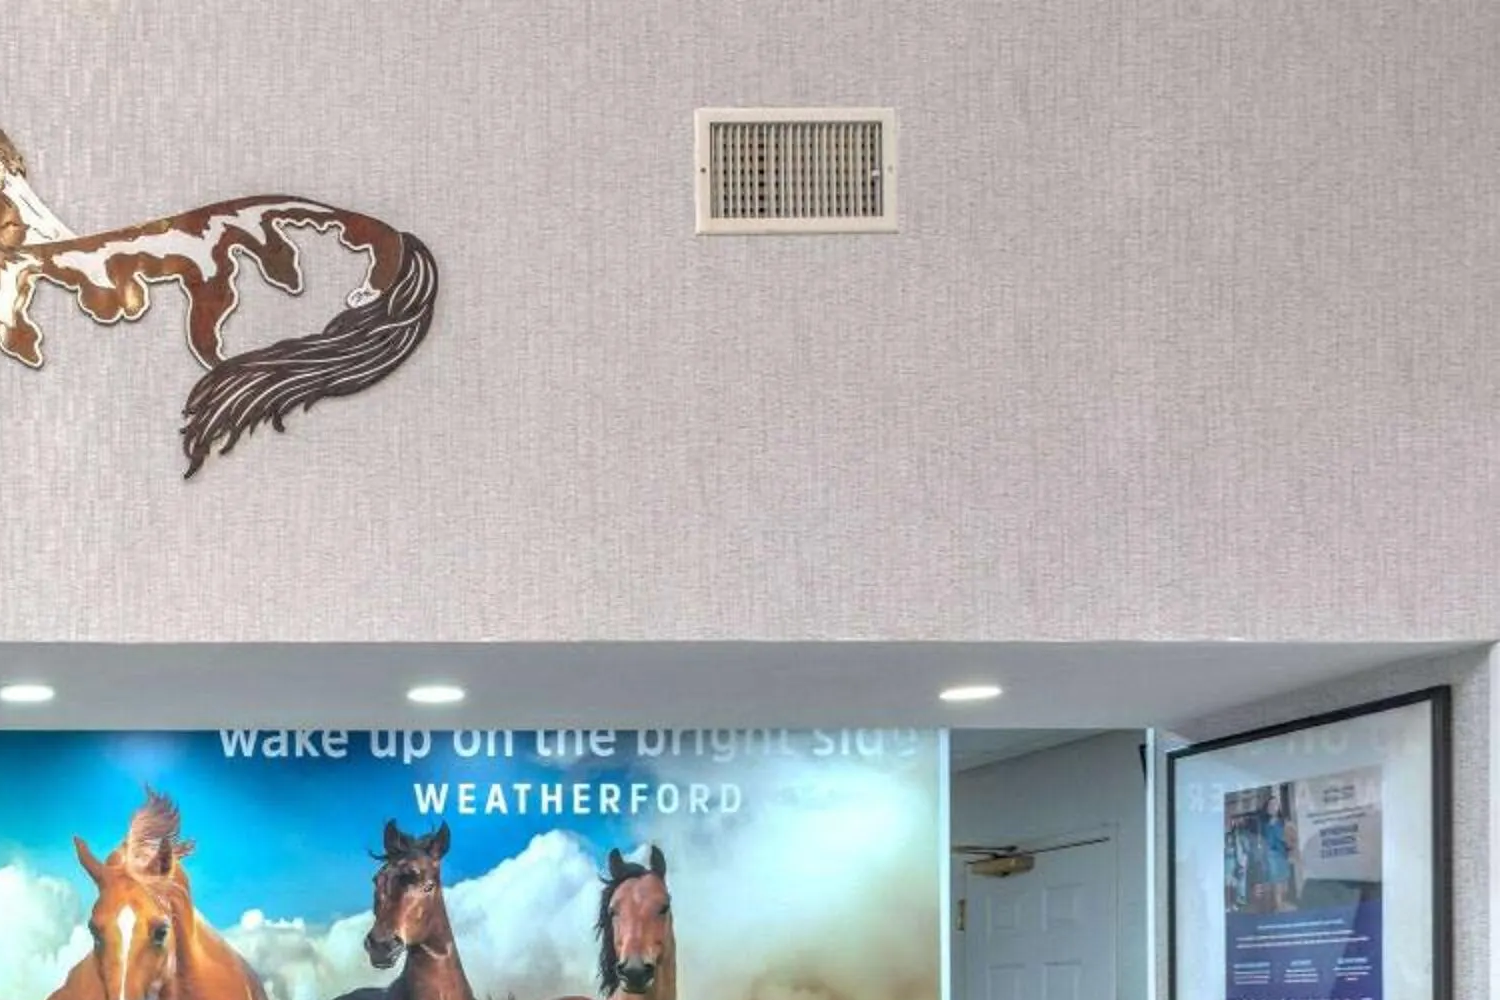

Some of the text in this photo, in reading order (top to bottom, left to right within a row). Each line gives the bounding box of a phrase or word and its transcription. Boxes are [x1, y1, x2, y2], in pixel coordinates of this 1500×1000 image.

[370, 730, 431, 764] up
[453, 730, 513, 757] on
[413, 783, 742, 814] WEATHERFORD
